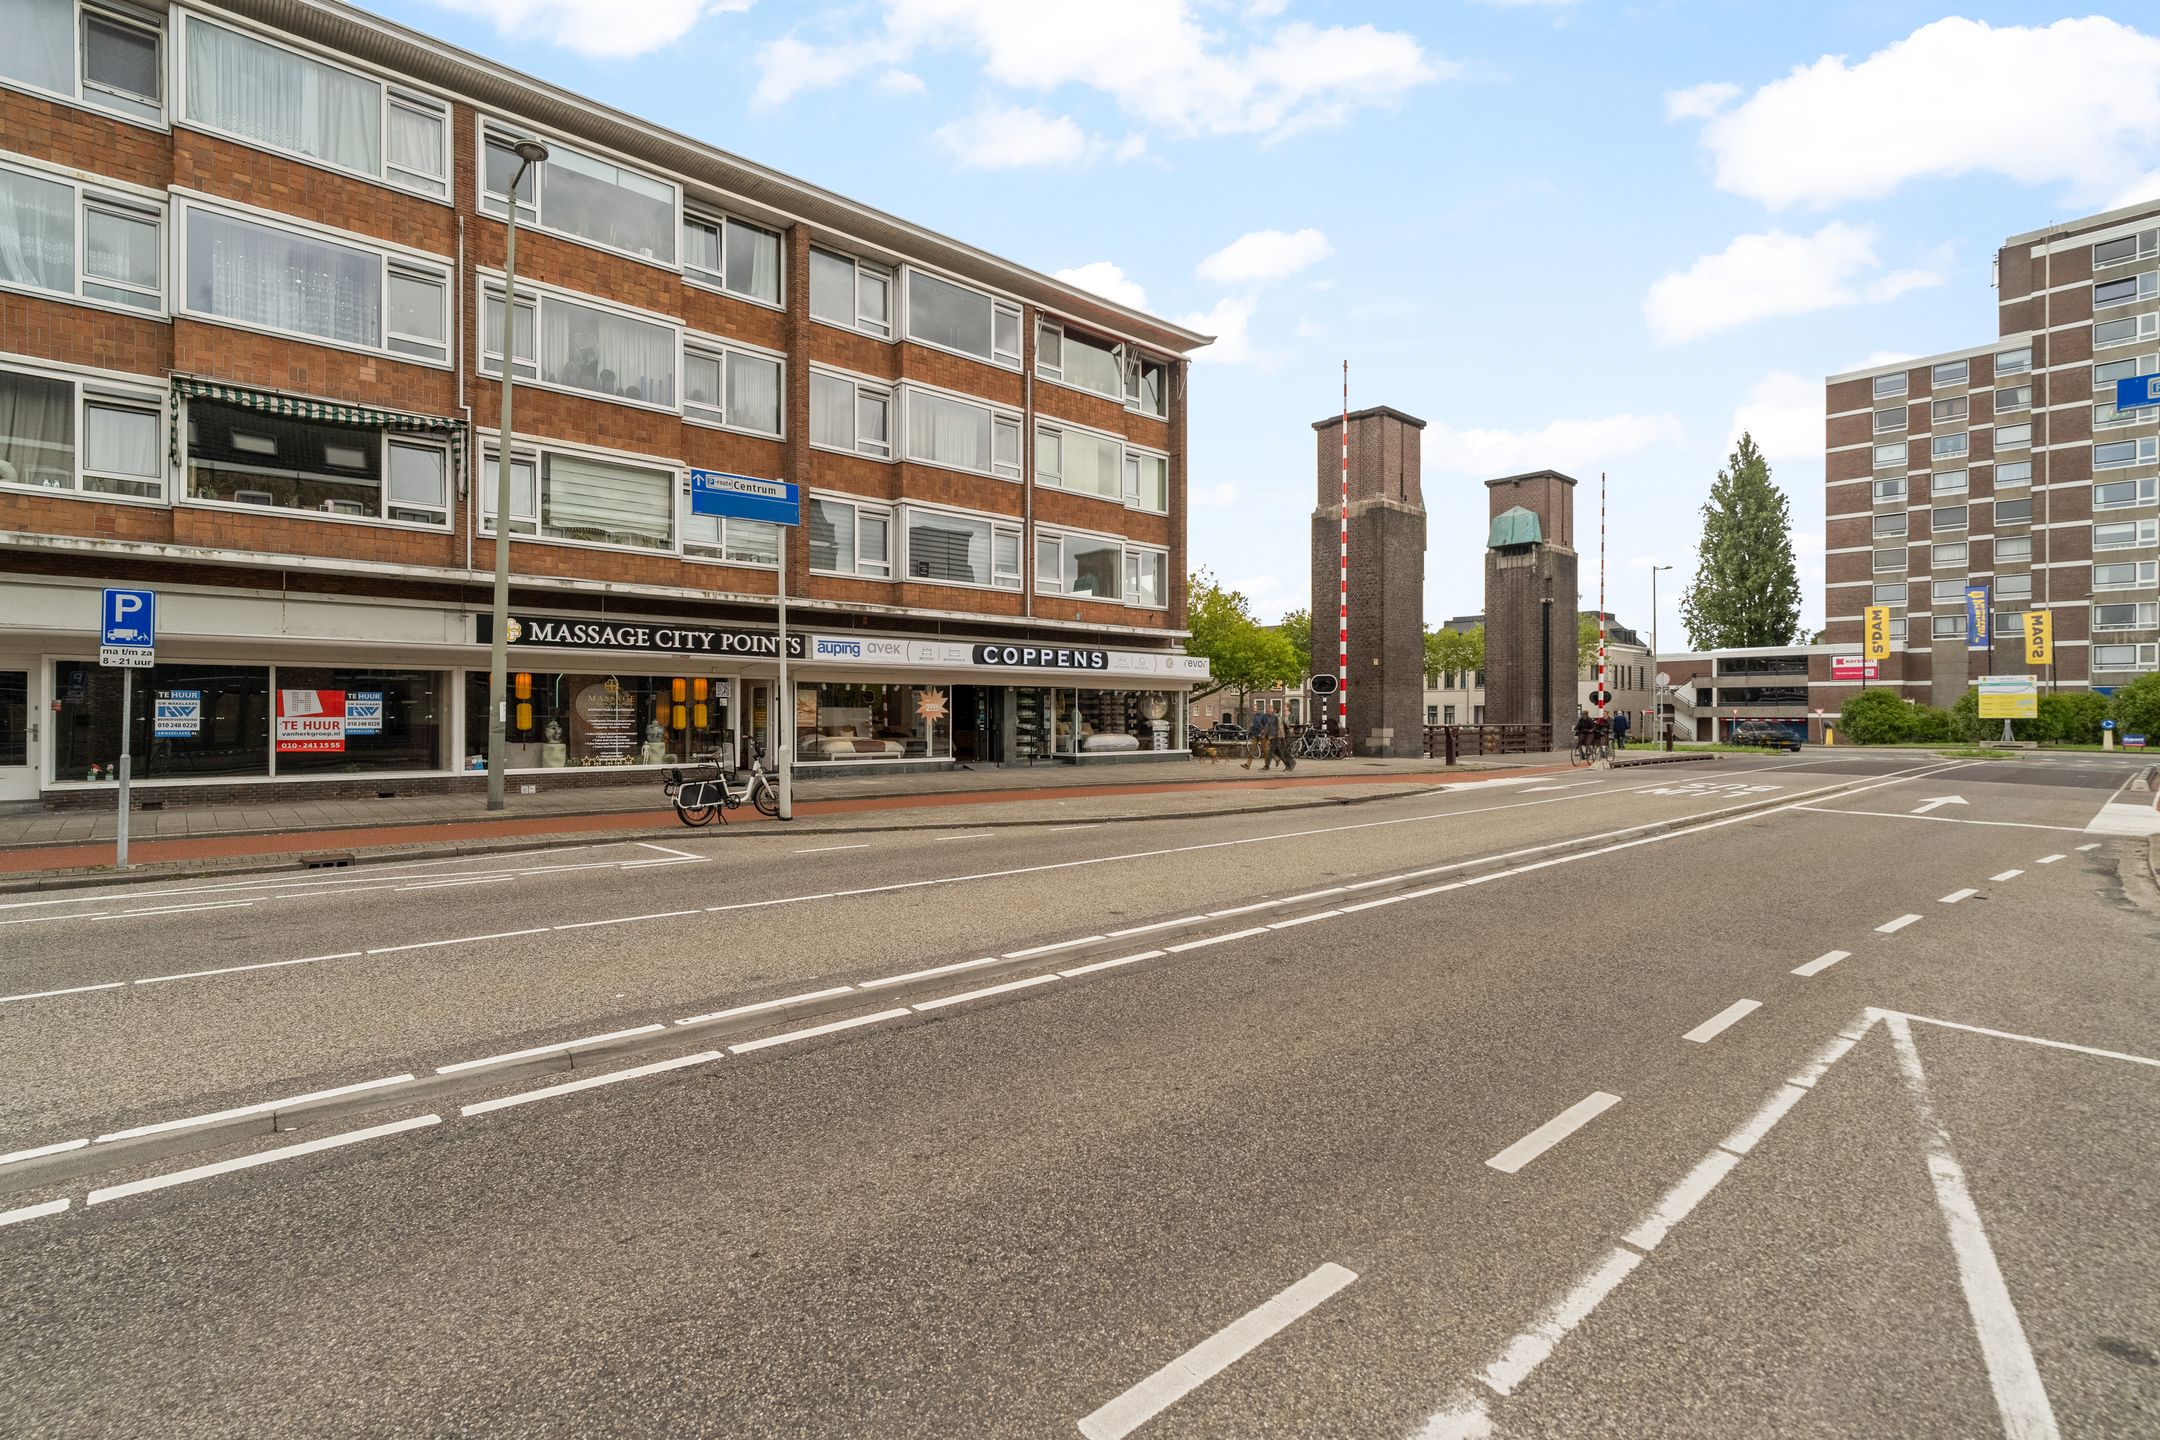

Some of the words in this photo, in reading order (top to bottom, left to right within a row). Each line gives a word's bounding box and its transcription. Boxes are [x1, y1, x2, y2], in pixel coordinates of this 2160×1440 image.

[733, 480, 777, 495] Centrum
[115, 594, 143, 623] P
[529, 620, 651, 648] MASSAGE
[653, 628, 716, 651] CITY
[1873, 609, 1883, 654] S'DAM
[122, 648, 138, 656] t/m
[817, 640, 861, 658] auping
[867, 641, 901, 655] avek
[982, 645, 1104, 669] COPPENS
[282, 720, 298, 730] TE
[303, 720, 341, 730] HUUR
